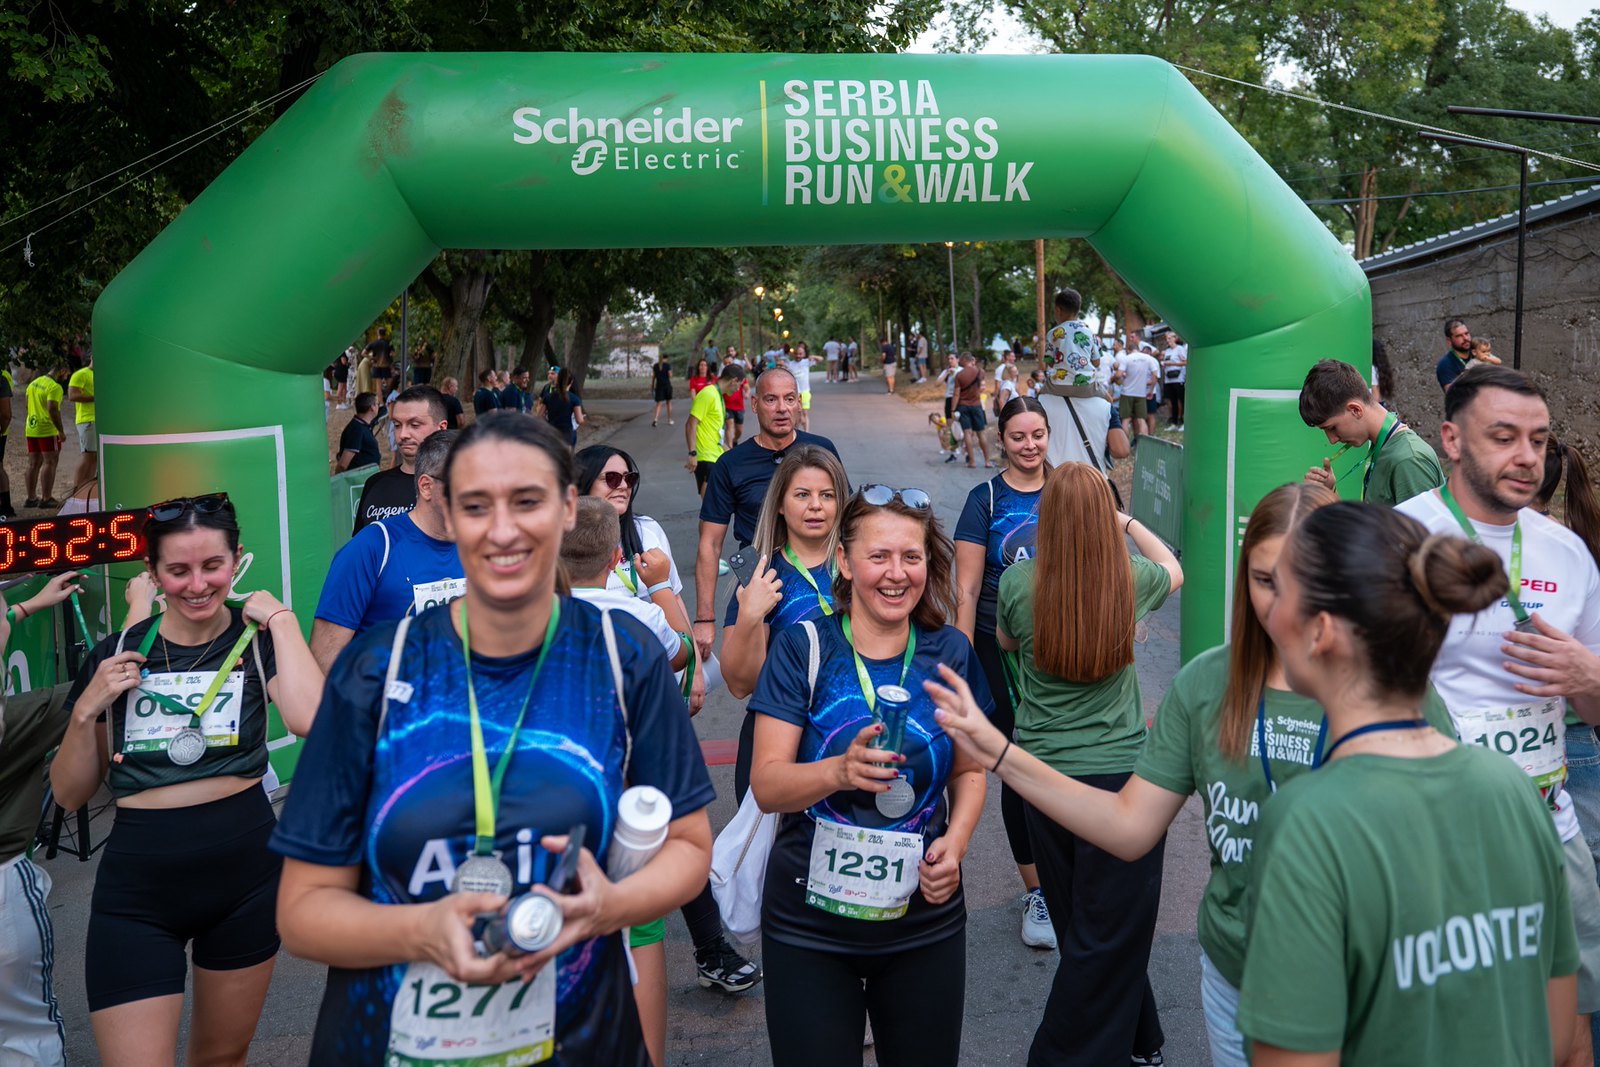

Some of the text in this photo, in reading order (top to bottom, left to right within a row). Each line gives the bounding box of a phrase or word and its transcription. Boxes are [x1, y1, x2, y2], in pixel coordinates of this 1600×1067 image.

[783, 79, 940, 117] SERBIA
[512, 107, 744, 145] Schneider
[785, 117, 999, 162] BUSINESS
[615, 147, 740, 170] Electric
[1475, 722, 1557, 756] 1024
[824, 848, 904, 883] 1231
[411, 974, 537, 1019] 1277
